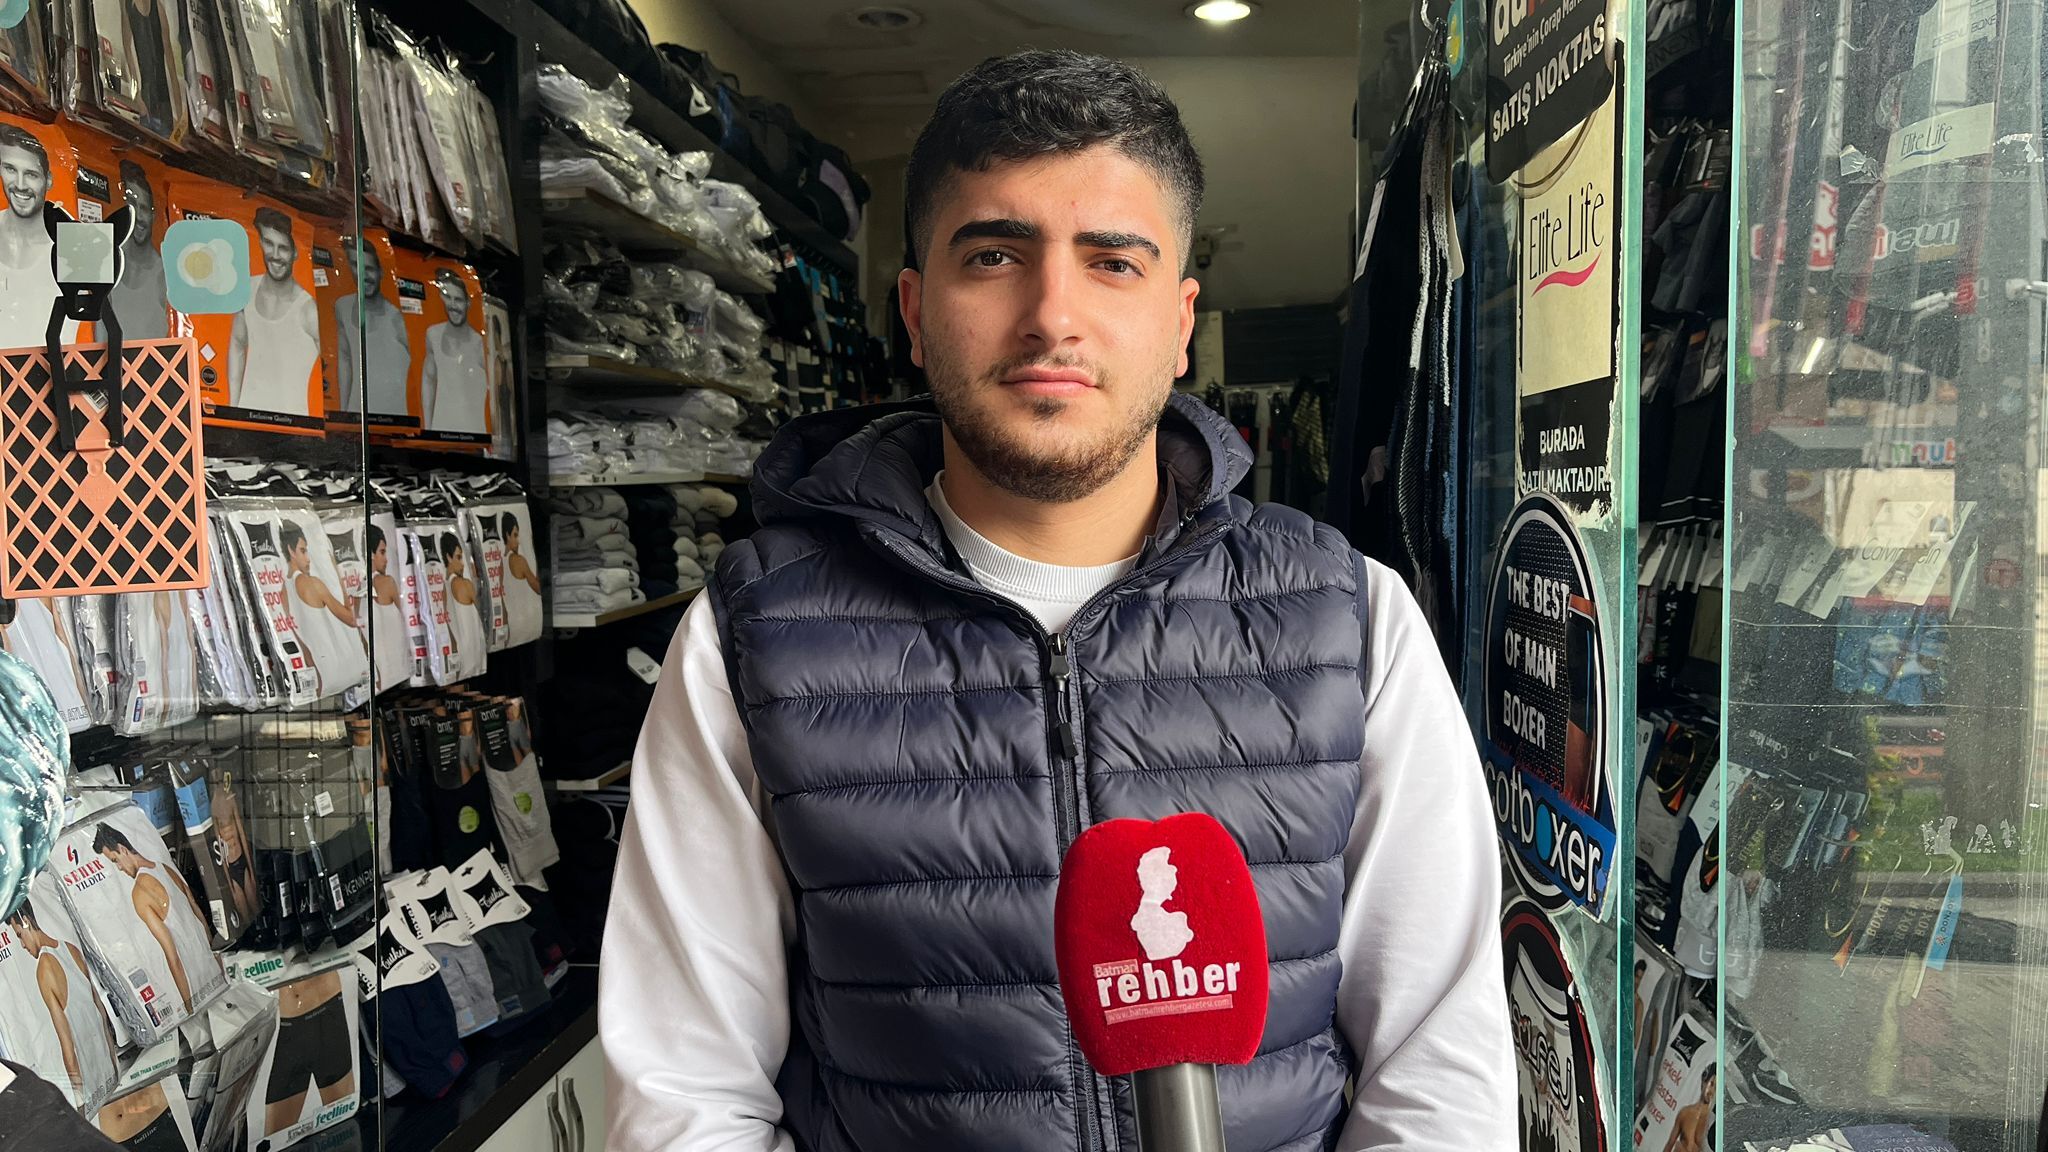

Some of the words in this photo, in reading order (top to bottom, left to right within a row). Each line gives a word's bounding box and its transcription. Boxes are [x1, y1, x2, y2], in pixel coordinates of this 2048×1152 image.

[1540, 7, 1561, 44] Çorap
[1493, 81, 1531, 142] SATIŞ
[1529, 208, 1562, 280] Elite
[1568, 182, 1604, 261] Life
[1540, 424, 1585, 454] BURADA
[257, 565, 283, 585] erkek
[1506, 566, 1530, 609] THE
[263, 591, 284, 611] spor
[273, 612, 298, 632] atlet
[1505, 627, 1521, 668] OF
[1525, 637, 1557, 689] MAN
[1503, 689, 1546, 750] BOXER
[63, 858, 105, 887] SEHER
[75, 872, 106, 892] YILDIZI
[1867, 897, 1892, 937] BOXER
[1095, 964, 1138, 977] Batman
[1097, 959, 1241, 1007] rehber
[315, 1101, 356, 1128] feelline
